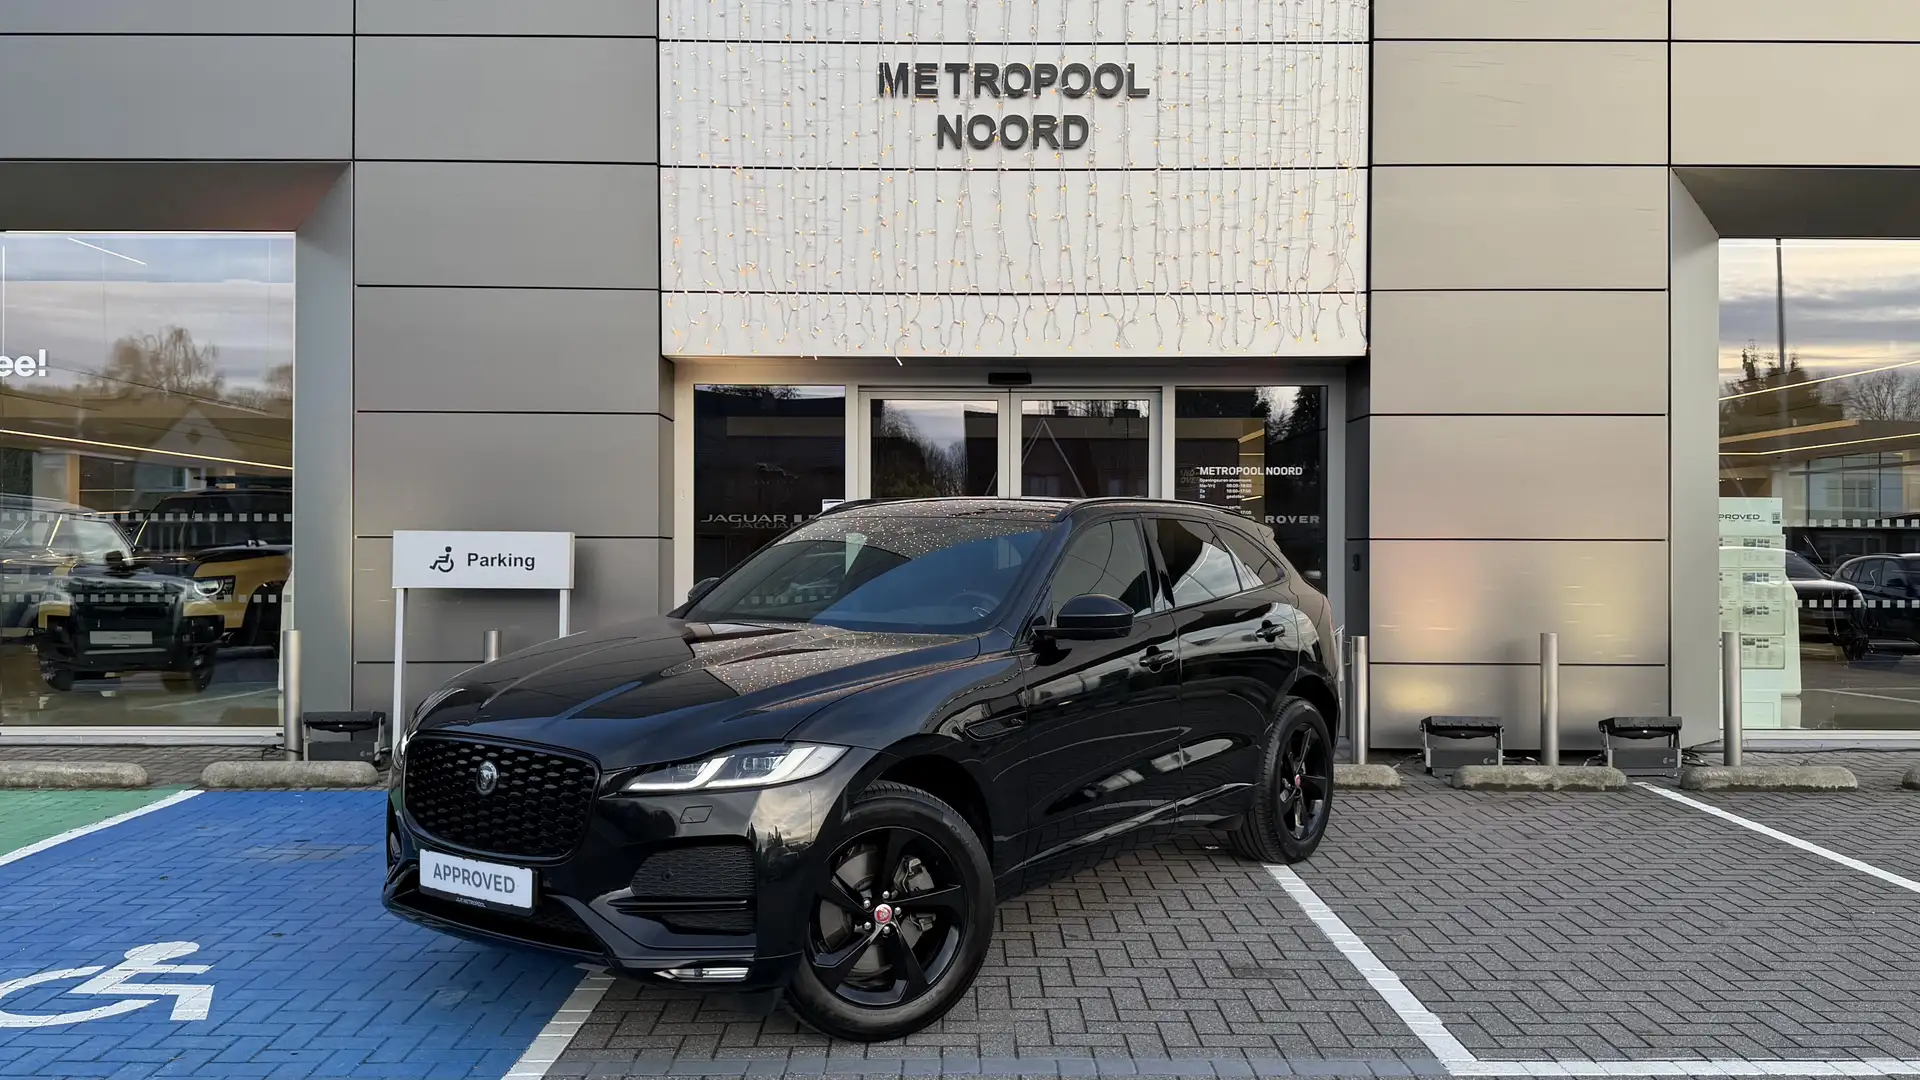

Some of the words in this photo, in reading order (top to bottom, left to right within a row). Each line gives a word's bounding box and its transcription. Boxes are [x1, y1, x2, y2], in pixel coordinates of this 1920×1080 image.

[878, 62, 1150, 98] METROPOOL
[937, 114, 1089, 149] NOORD
[1200, 467, 1264, 476] METROPOOL
[1266, 467, 1303, 476] NOORD
[701, 514, 787, 523] JAGUAR
[1265, 515, 1320, 524] ROVER
[467, 552, 535, 571] Parking
[433, 862, 516, 894] APPROVED
